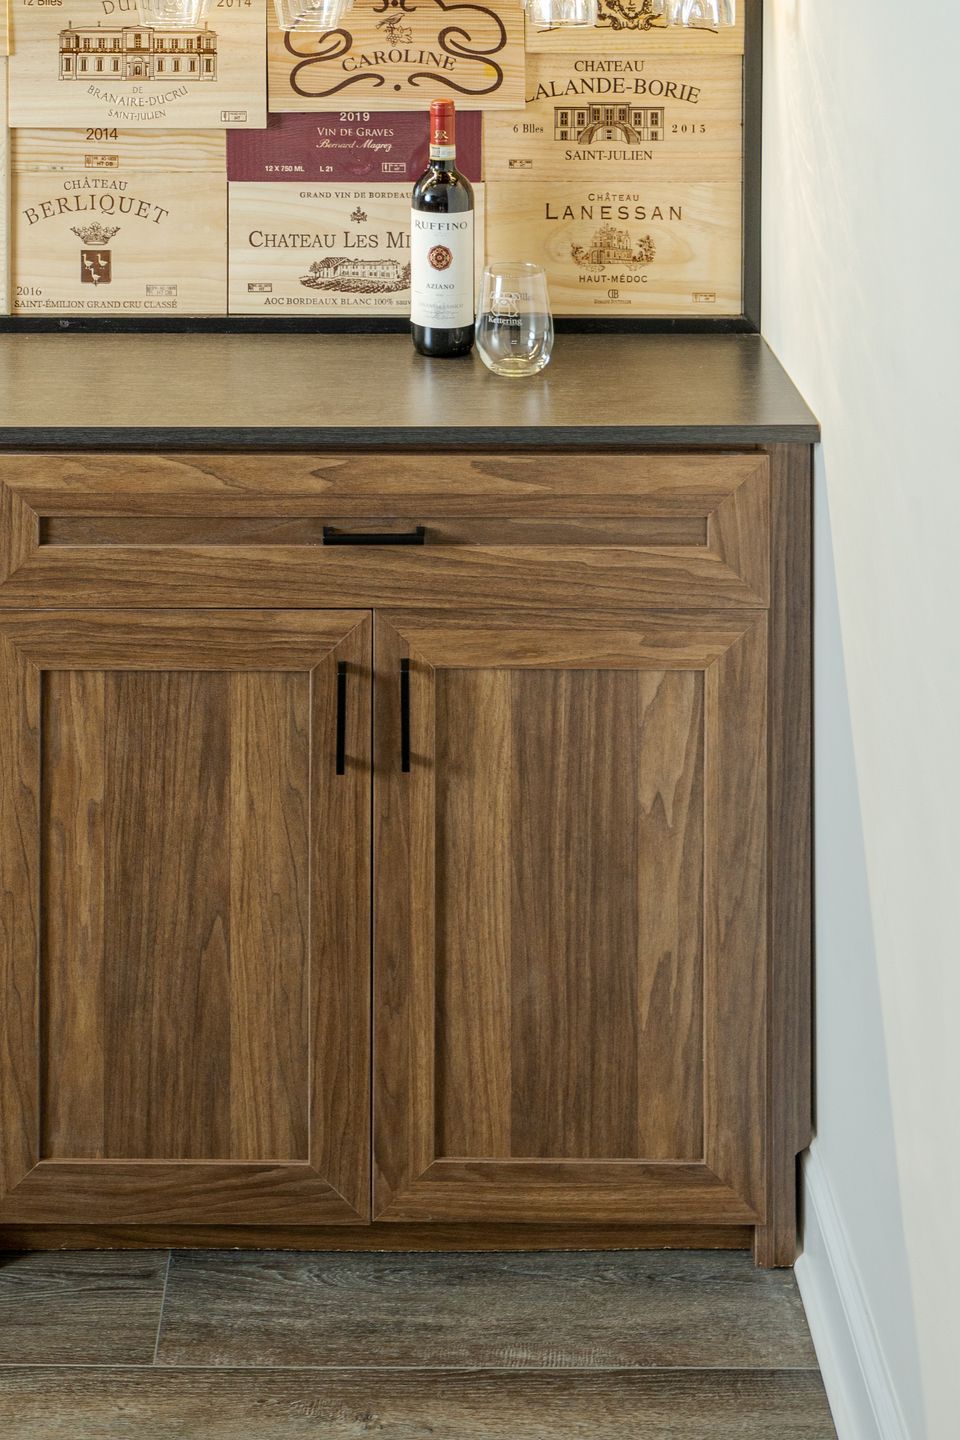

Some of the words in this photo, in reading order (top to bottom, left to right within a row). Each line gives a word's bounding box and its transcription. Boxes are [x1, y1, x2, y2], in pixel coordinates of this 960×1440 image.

[342, 48, 457, 73] CAROLINE
[574, 60, 645, 72] CHATEAU
[132, 86, 144, 94] DE
[87, 84, 189, 108] BRANAIRE-DUCRU
[108, 108, 167, 121] SAINT-JULIEN
[339, 111, 370, 122] 2019
[85, 127, 119, 141] 2014
[316, 127, 337, 137] VIN
[340, 127, 353, 137] DE
[356, 127, 394, 137] GRAVES
[513, 125, 519, 133] 6
[671, 124, 706, 134] 2015
[315, 140, 356, 150] Bernard
[356, 140, 393, 153] Magrez
[565, 150, 653, 161] SAINT-JULIEN
[63, 176, 128, 191] CHÂTEAU
[299, 191, 332, 199] GRAND
[334, 191, 351, 199] VIN
[353, 191, 367, 199] DE
[588, 192, 640, 202] CHÂTEAU
[22, 193, 169, 225] BERLIQUET
[545, 202, 683, 221] LANESSAN
[414, 220, 468, 231] RUFFINO
[248, 230, 336, 249] CHATEAU
[343, 231, 379, 249] LES
[579, 273, 648, 283] HAUT-MÉDOC
[16, 286, 42, 297] 2016
[14, 298, 85, 309] SAINT-ÉMILION
[87, 299, 121, 309] GRAND
[122, 299, 141, 309] CRU
[143, 298, 178, 309] CLASSÉ
[264, 296, 285, 305] AOC
[286, 296, 338, 305] BORDEAUX
[340, 296, 373, 305] BLANC
[374, 296, 394, 305] 100%
